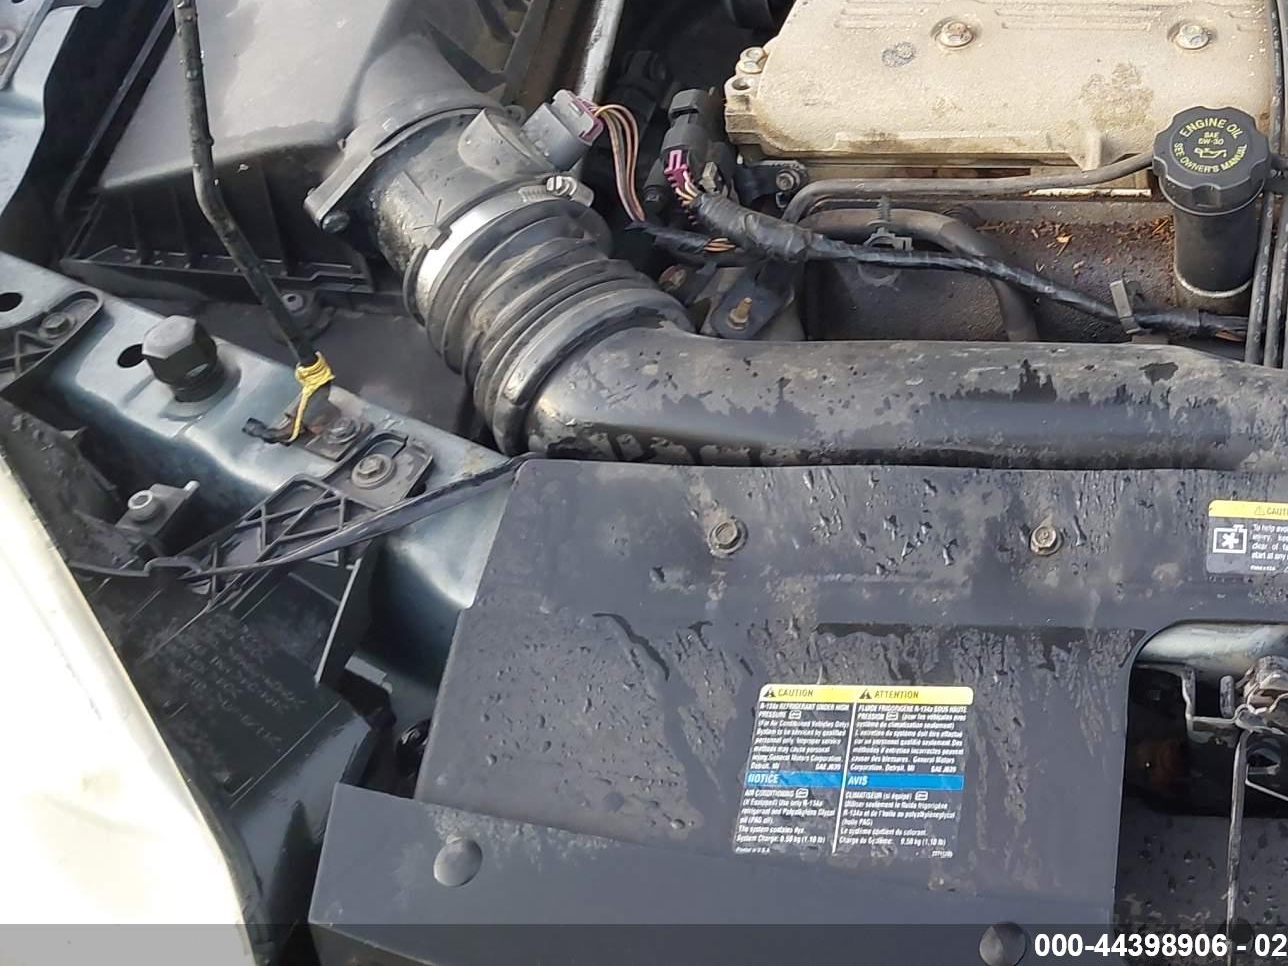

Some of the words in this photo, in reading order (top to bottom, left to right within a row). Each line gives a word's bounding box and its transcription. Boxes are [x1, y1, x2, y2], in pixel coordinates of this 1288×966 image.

[1179, 118, 1227, 137] ENGINE
[1226, 123, 1243, 139] OIL
[1174, 143, 1185, 157] SEE
[1180, 157, 1220, 173] OWNER'S
[1221, 144, 1247, 170] MANUAL
[875, 691, 919, 699] ATTENTION
[748, 774, 779, 783] NOTICE
[848, 776, 868, 785] AVIS
